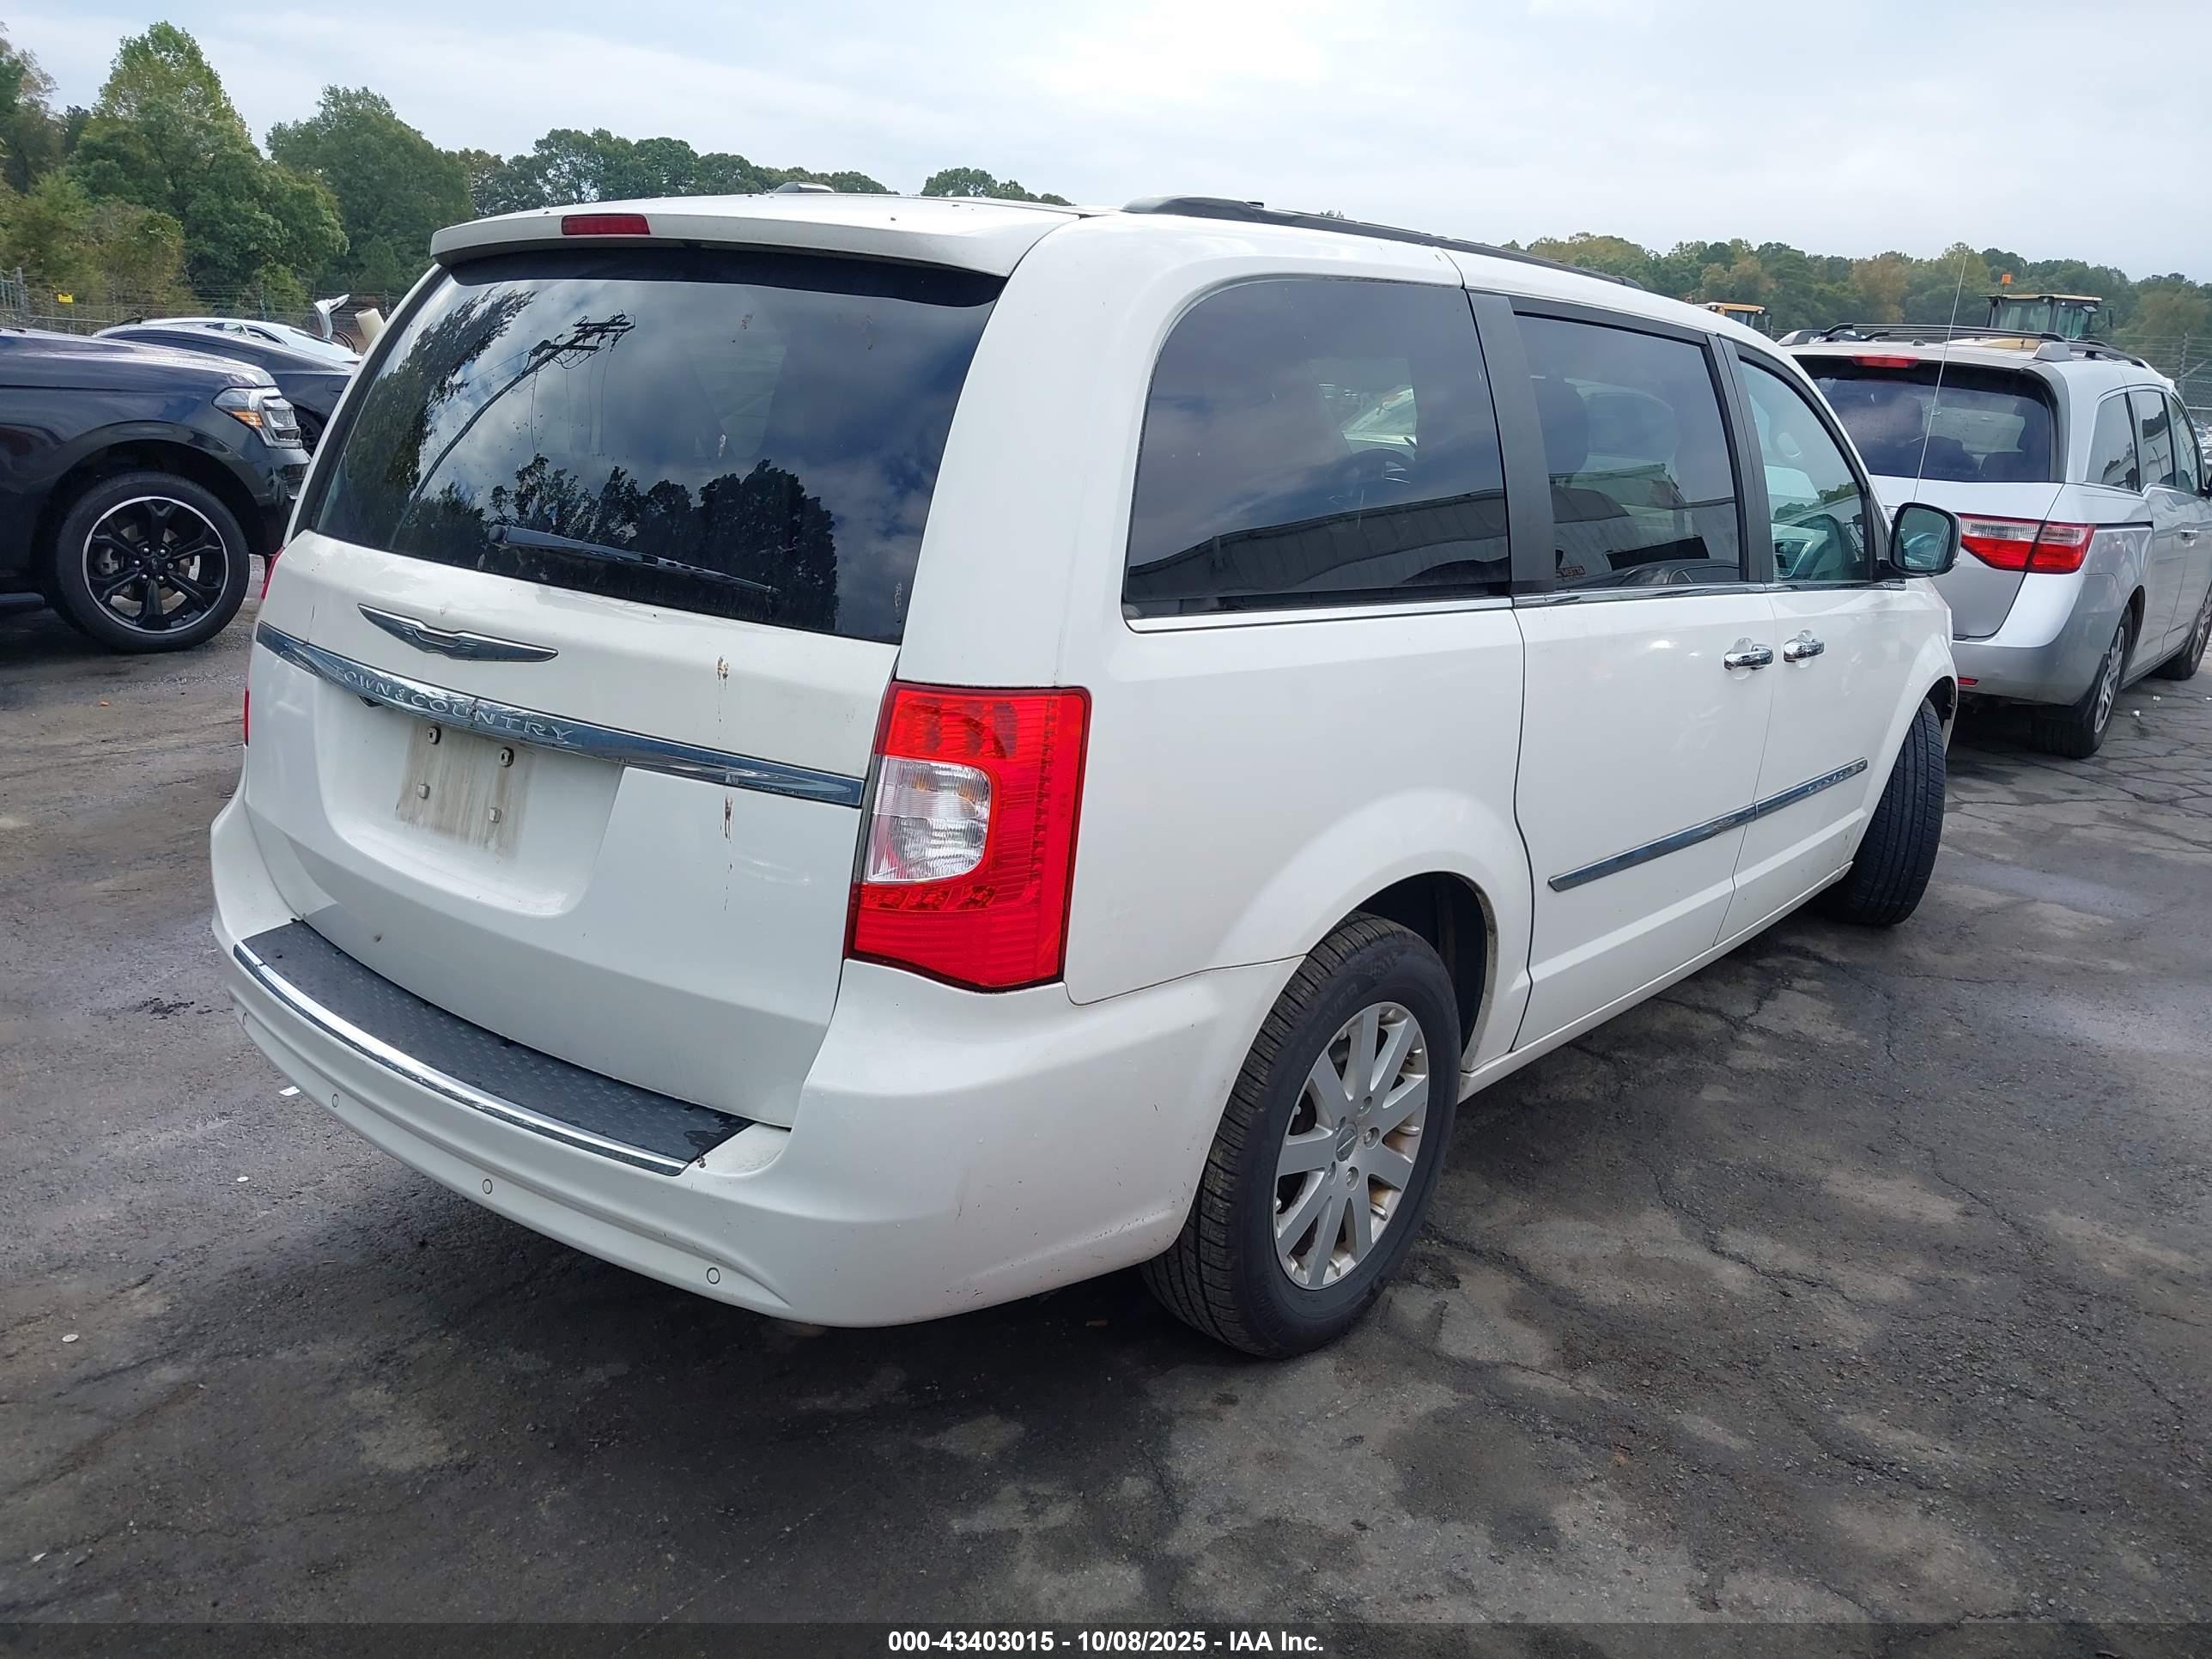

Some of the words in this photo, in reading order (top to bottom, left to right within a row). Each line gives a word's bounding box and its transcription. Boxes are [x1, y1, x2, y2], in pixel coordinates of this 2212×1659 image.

[333, 665, 391, 696] TOWN
[395, 688, 405, 702] &
[411, 694, 574, 741] COUNTRY
